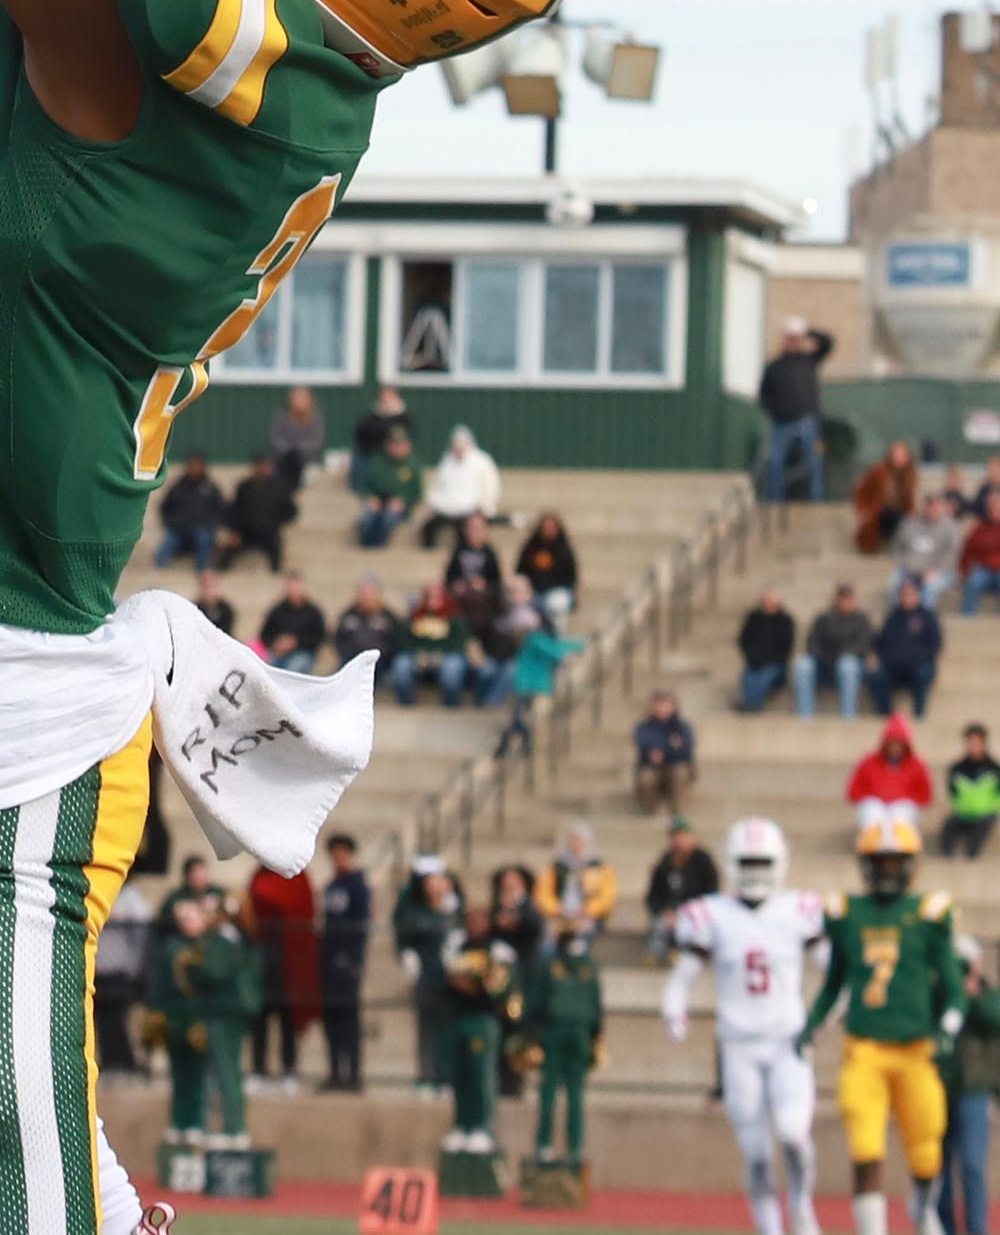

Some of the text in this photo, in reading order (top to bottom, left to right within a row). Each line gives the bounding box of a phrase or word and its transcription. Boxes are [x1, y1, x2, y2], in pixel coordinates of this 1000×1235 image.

[181, 667, 248, 763] RIP
[199, 718, 303, 795] MOM
[744, 946, 771, 997] 5
[862, 940, 900, 1008] 7
[369, 1177, 424, 1225] 40
